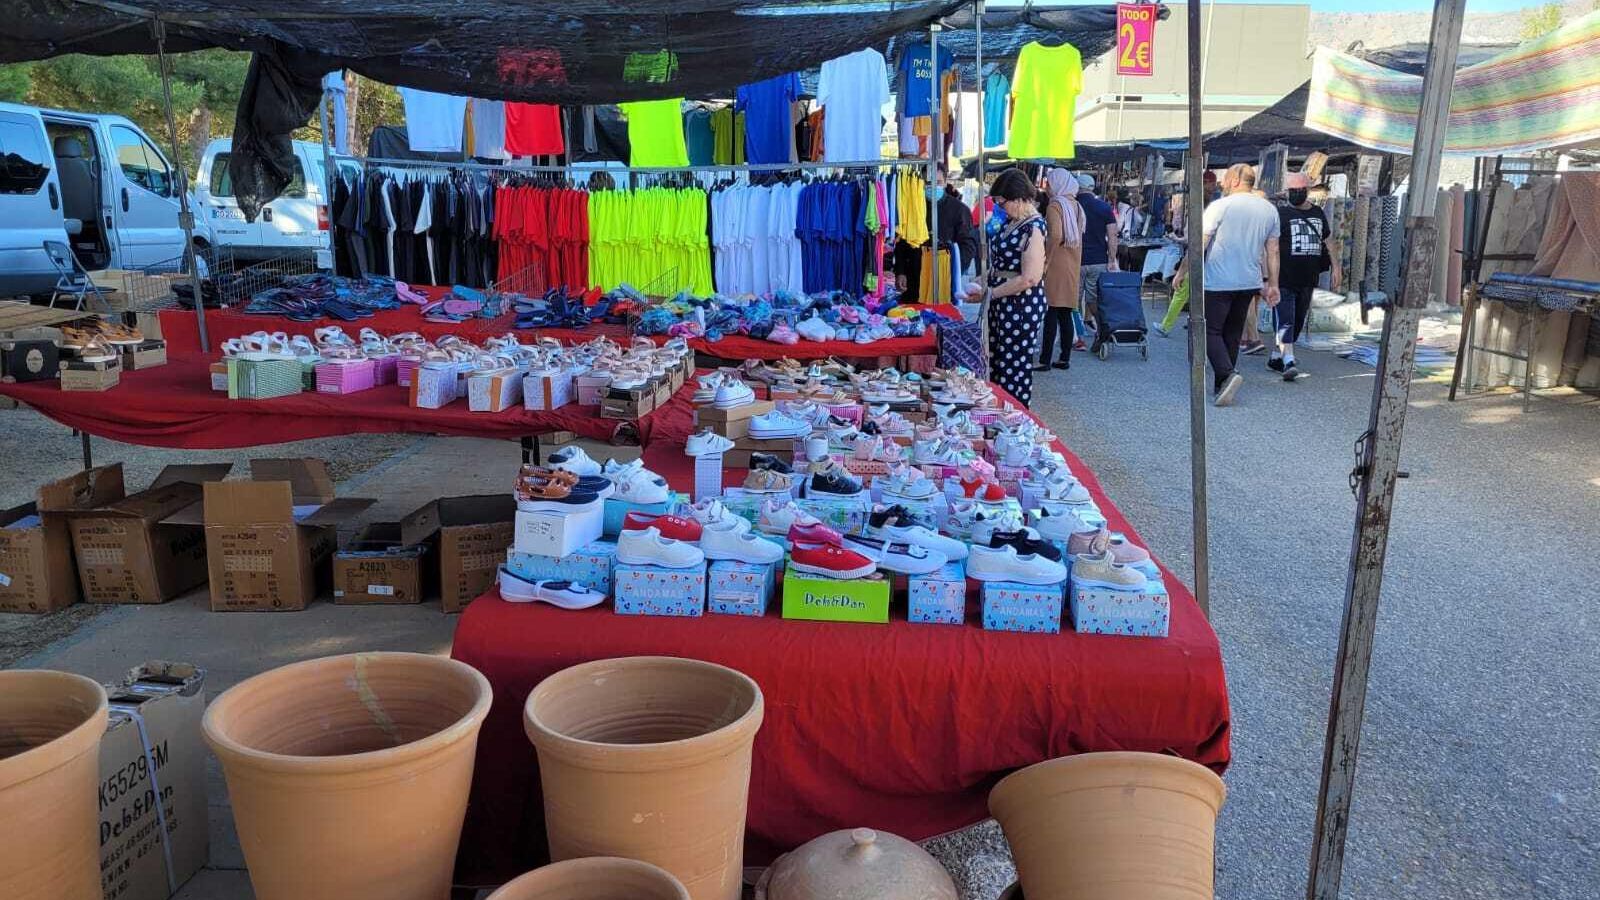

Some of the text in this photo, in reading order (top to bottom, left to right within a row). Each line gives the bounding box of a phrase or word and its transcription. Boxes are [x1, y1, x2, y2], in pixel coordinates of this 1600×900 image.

[1120, 9, 1150, 21] TODO
[1120, 22, 1150, 68] 2€
[915, 69, 932, 79] BOSS
[632, 587, 684, 599] ANDAMAS
[805, 592, 866, 609] Deb&Dan
[1000, 606, 1045, 618] ANDAMAS
[1096, 606, 1152, 619] ANDAMAS
